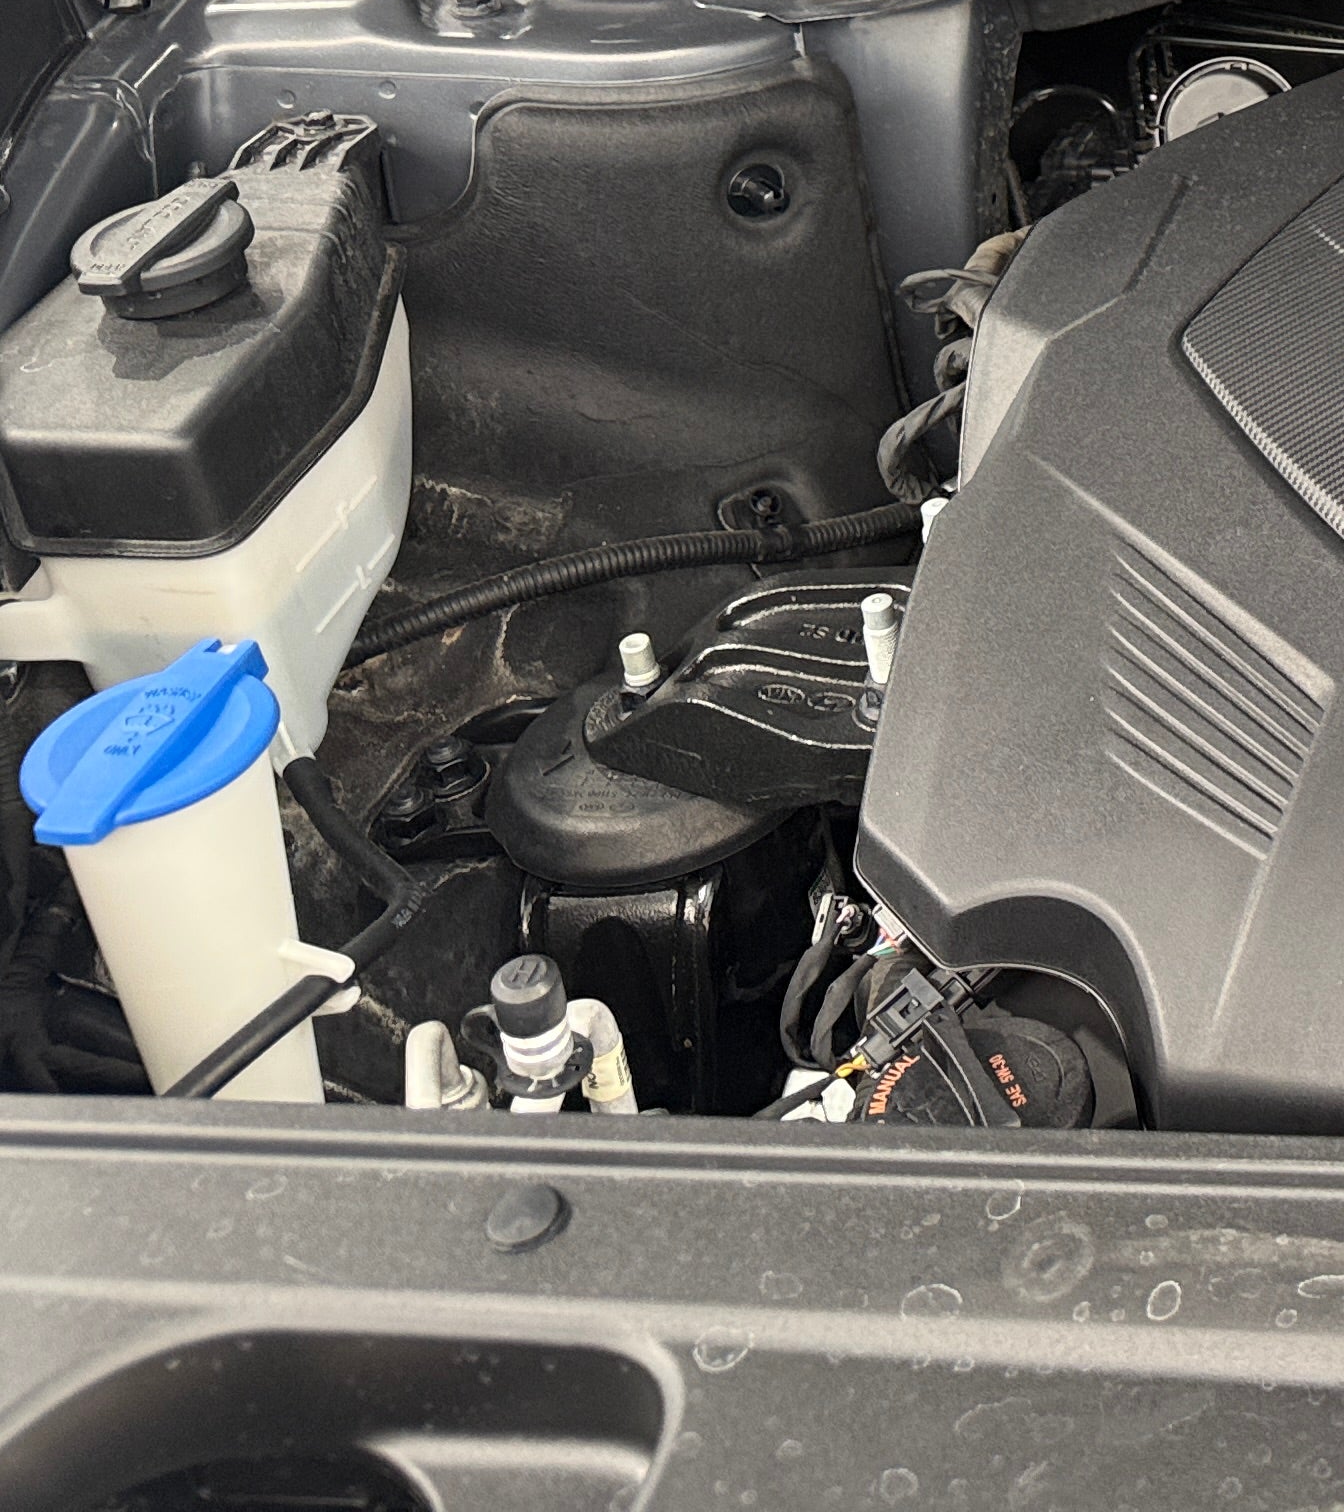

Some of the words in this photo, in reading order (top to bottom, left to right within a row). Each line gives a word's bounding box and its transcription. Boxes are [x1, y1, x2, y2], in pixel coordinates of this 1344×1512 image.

[867, 1054, 921, 1116] MANUAL
[987, 1053, 1017, 1086] 5W-30
[1002, 1082, 1029, 1109] SAE
